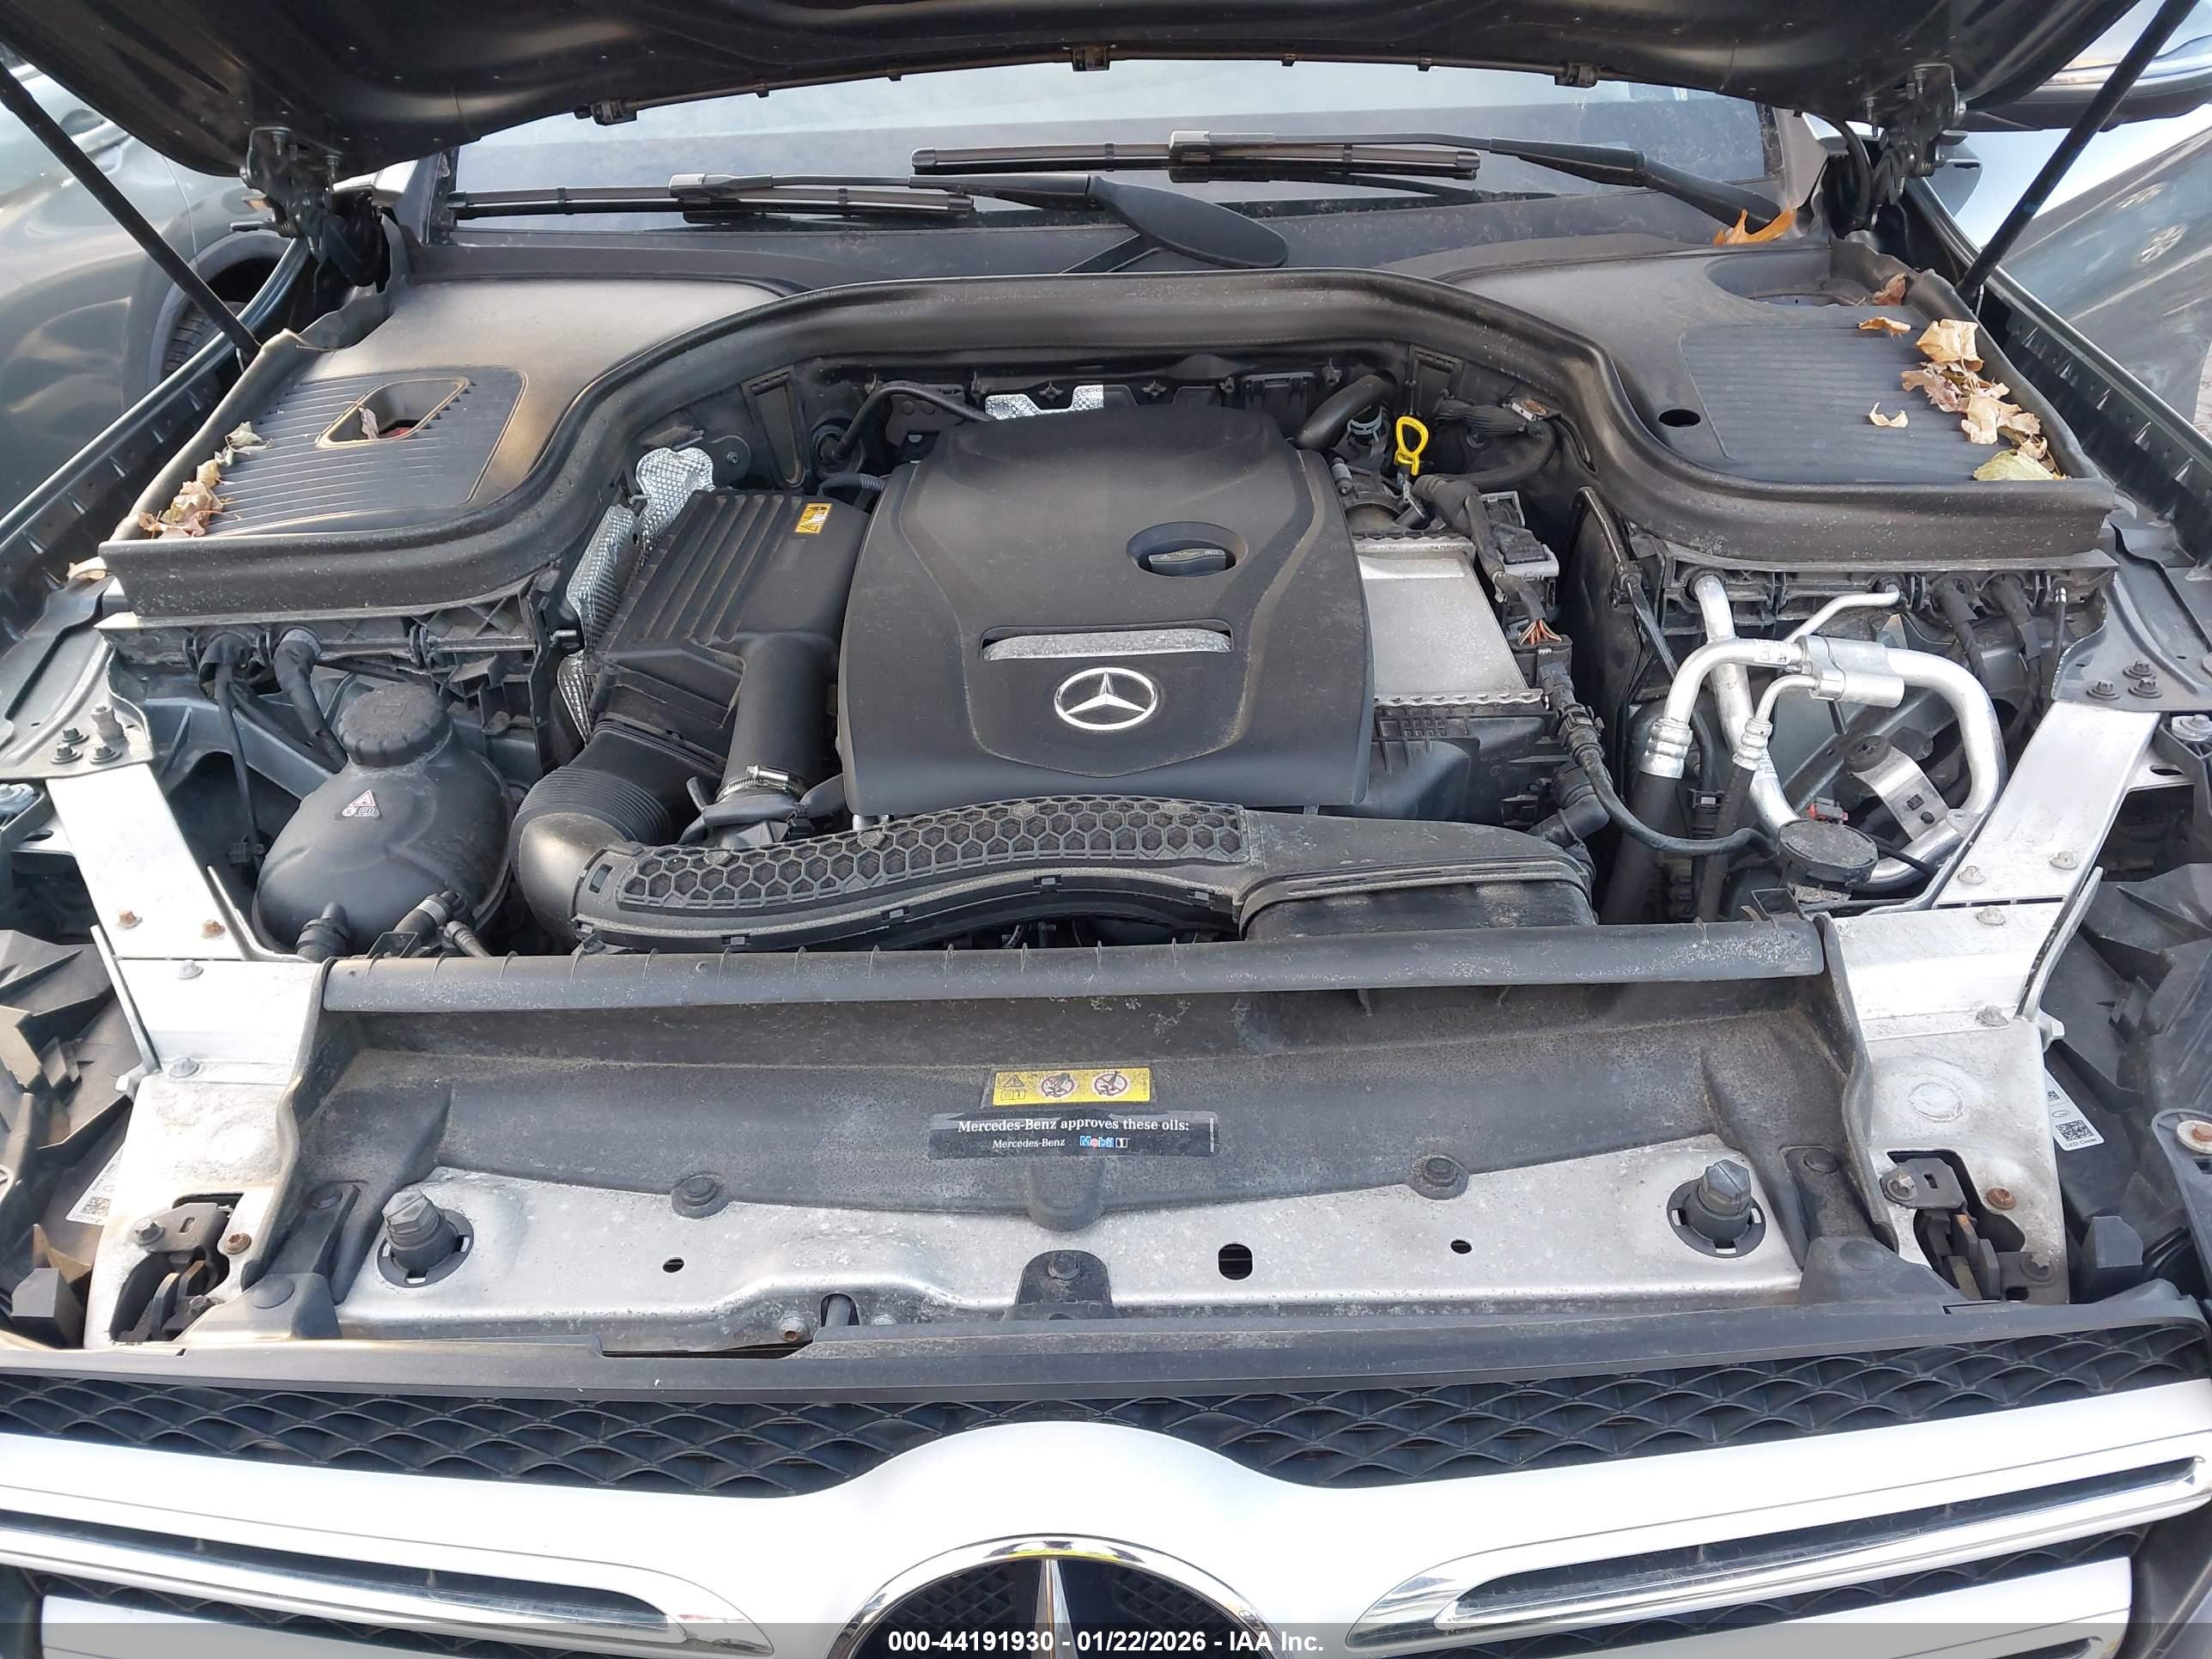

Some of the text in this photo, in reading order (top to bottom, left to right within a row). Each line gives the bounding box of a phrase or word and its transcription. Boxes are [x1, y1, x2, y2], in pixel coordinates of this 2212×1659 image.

[957, 1118, 1190, 1133] Mercedes-Benz approves these oils:
[992, 1138, 1066, 1149] Mercedes-Benz
[1079, 1135, 1115, 1148] Mobil
